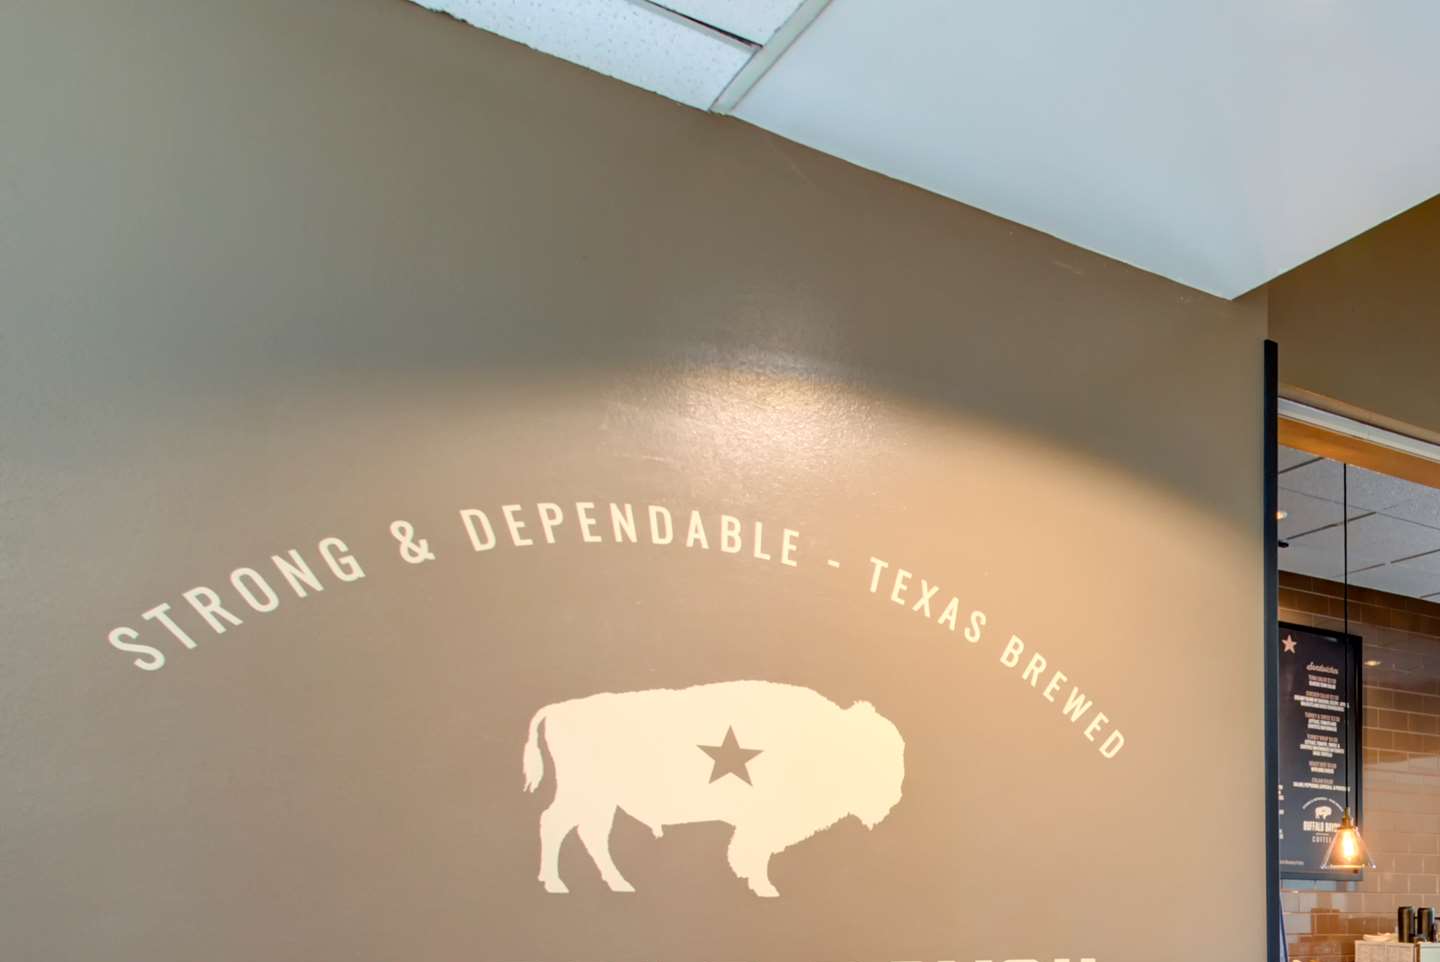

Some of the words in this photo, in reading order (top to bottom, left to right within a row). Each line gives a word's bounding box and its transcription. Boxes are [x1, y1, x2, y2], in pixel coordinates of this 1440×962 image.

[108, 536, 367, 671] STRONG
[389, 519, 436, 564] &
[459, 501, 800, 568] DEPENDABLE
[869, 556, 987, 644] TEXAS
[1000, 634, 1126, 760] BREWED
